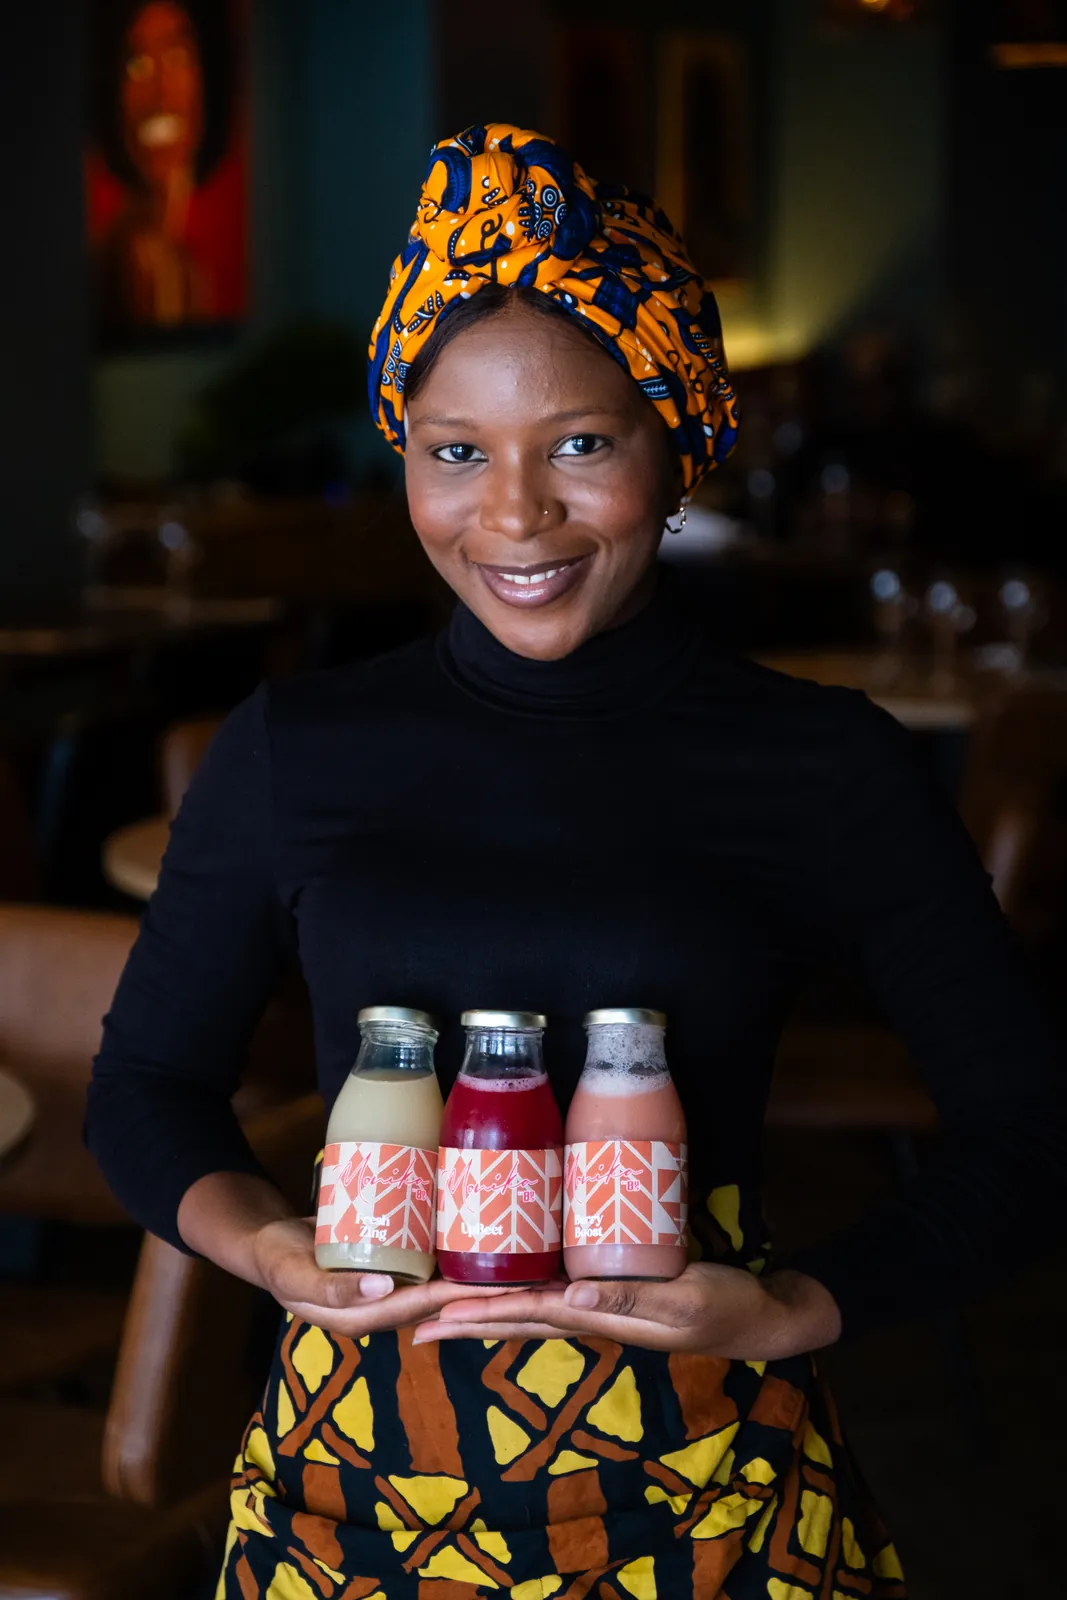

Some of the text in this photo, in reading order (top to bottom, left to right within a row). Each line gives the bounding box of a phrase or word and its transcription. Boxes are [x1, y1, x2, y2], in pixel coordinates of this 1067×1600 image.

[328, 1152, 430, 1204] Monika
[564, 1149, 643, 1204] Monika
[441, 1158, 538, 1213] Monika
[574, 1213, 604, 1227] Berry
[359, 1224, 387, 1241] Zing
[461, 1222, 503, 1238] UpBeet
[575, 1226, 603, 1238] Boost
